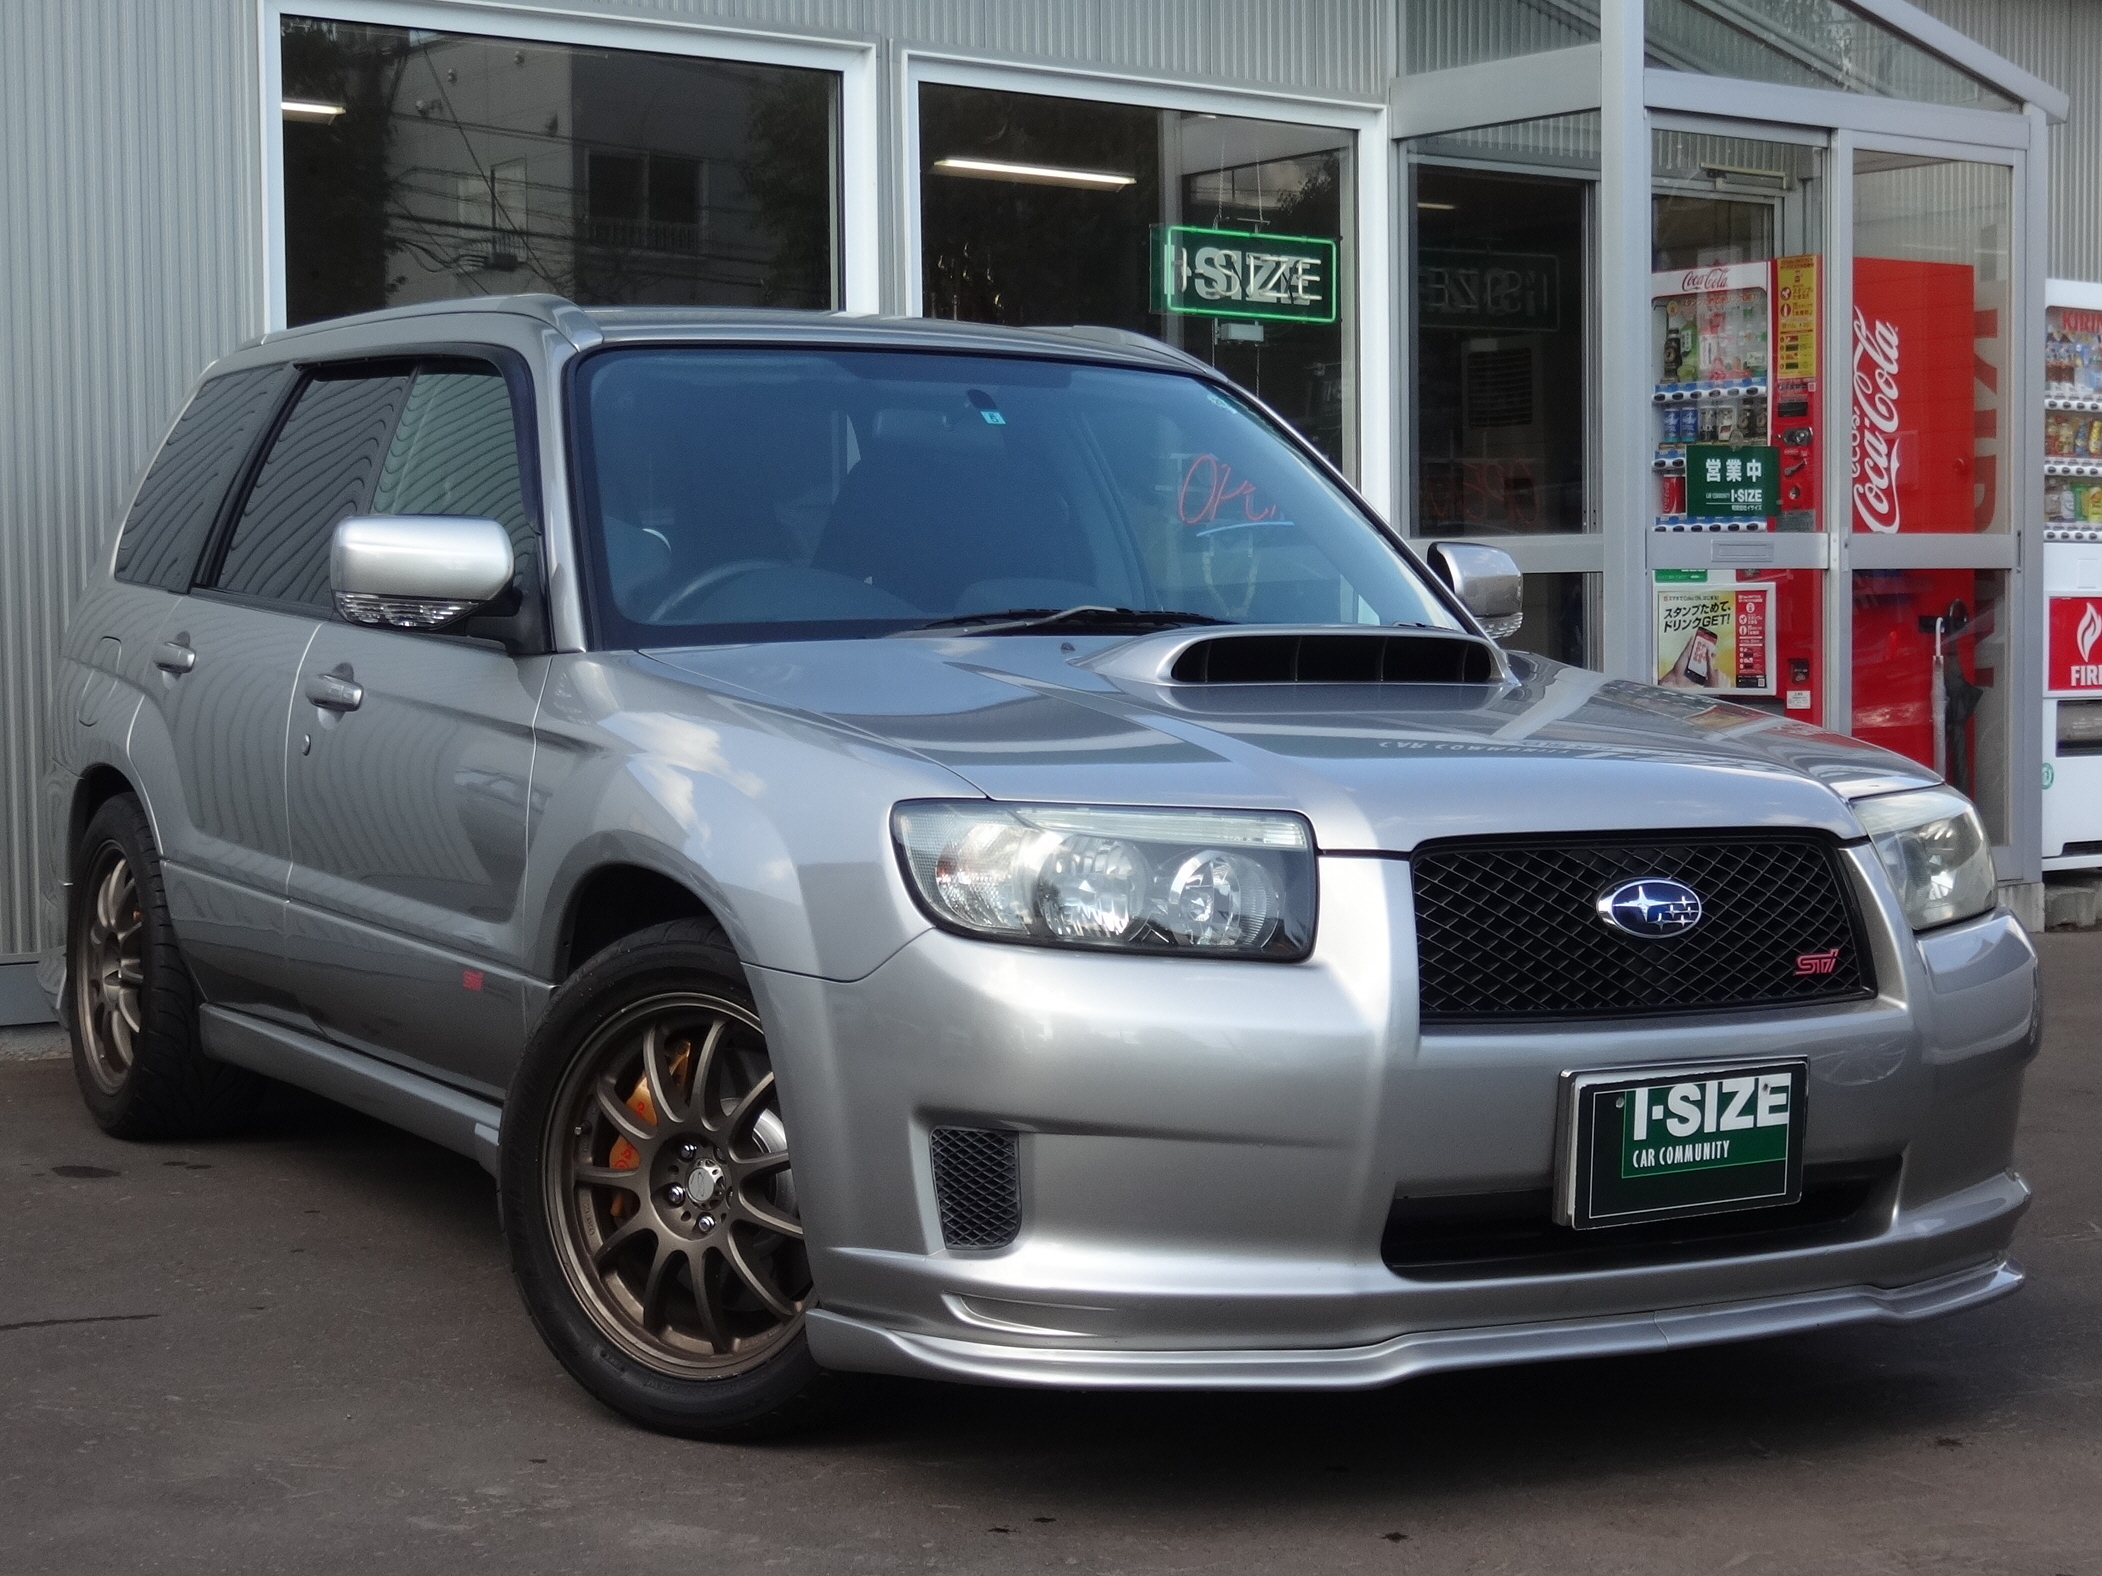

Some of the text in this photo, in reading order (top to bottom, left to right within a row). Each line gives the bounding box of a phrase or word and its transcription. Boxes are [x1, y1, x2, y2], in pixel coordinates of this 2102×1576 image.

[1682, 268, 1730, 291] Coca-Cola
[1852, 304, 1899, 534] Coca-Cola
[1705, 458, 1762, 482] 営業中
[1632, 1140, 1730, 1168] CAR COMMUNITY
